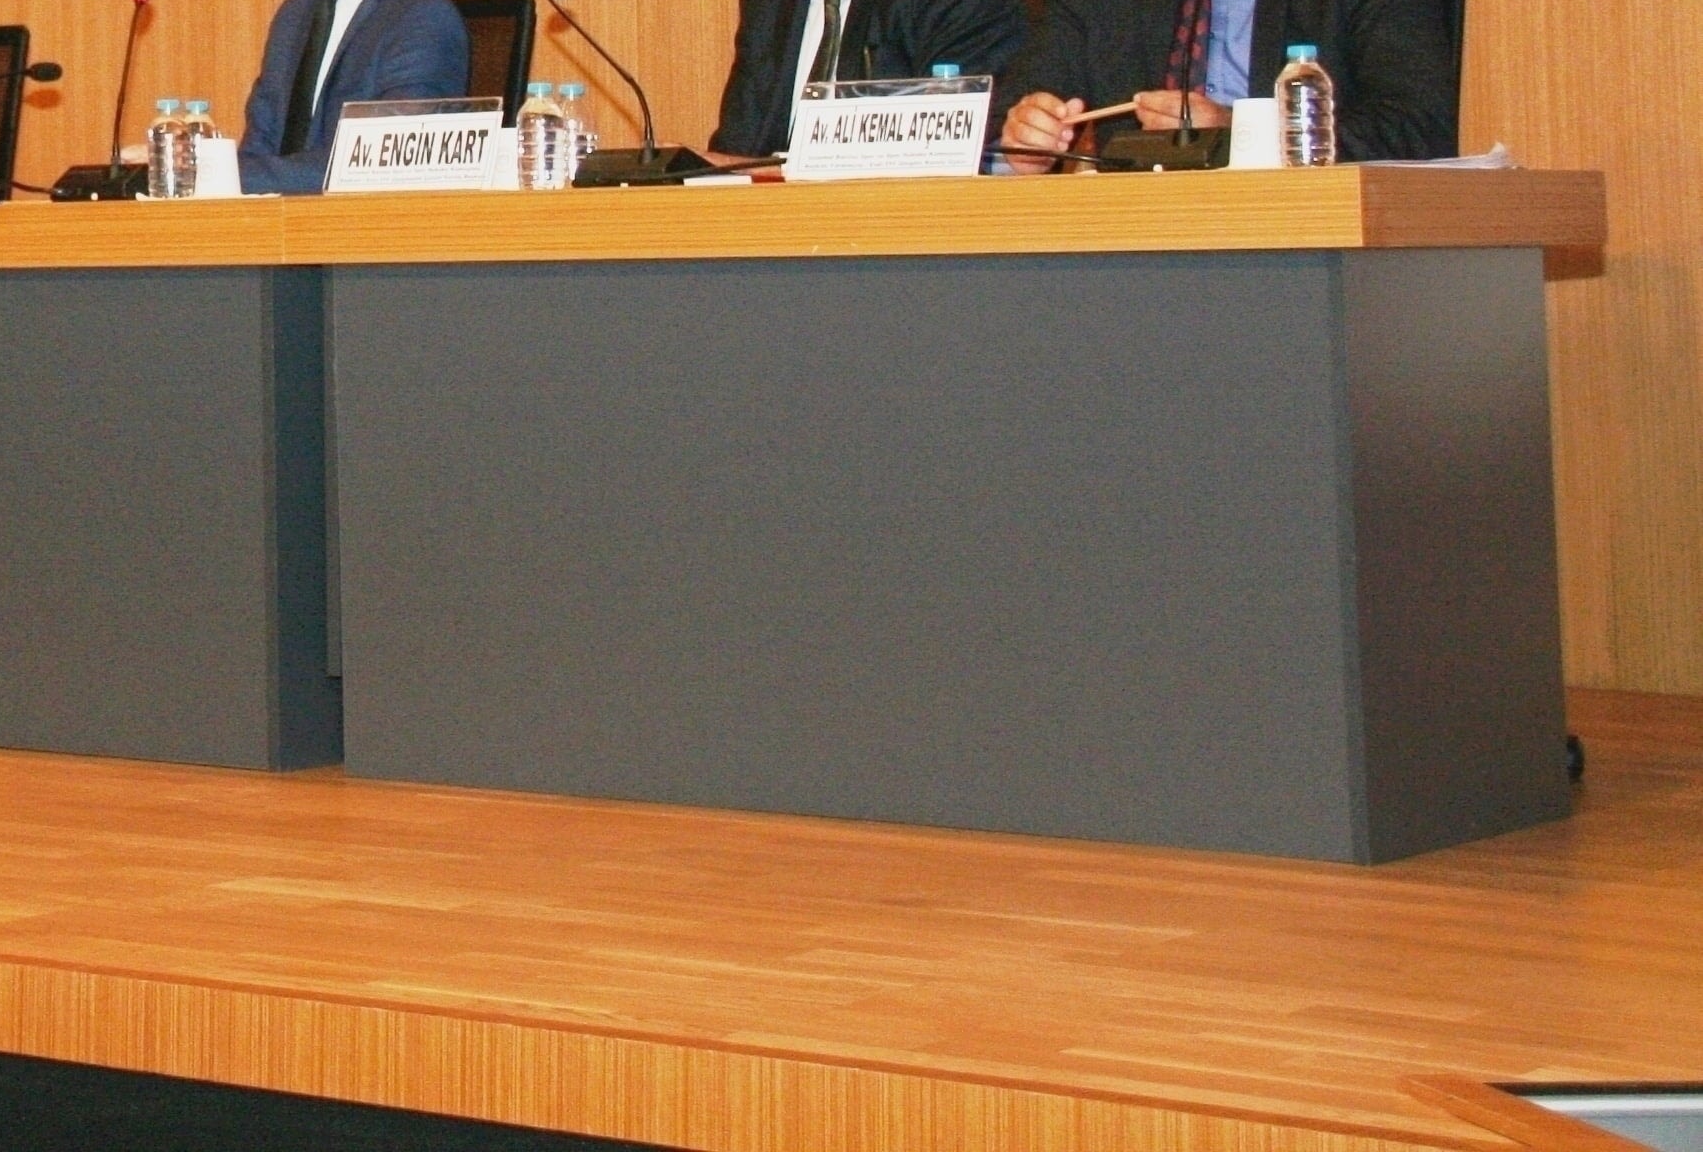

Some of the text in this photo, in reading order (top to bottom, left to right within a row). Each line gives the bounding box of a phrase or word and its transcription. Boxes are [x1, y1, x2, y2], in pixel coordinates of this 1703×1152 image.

[348, 122, 489, 168] Av. ENGİN KART
[809, 105, 974, 149] Av. ALİ KEMAL ATÇEKEN
